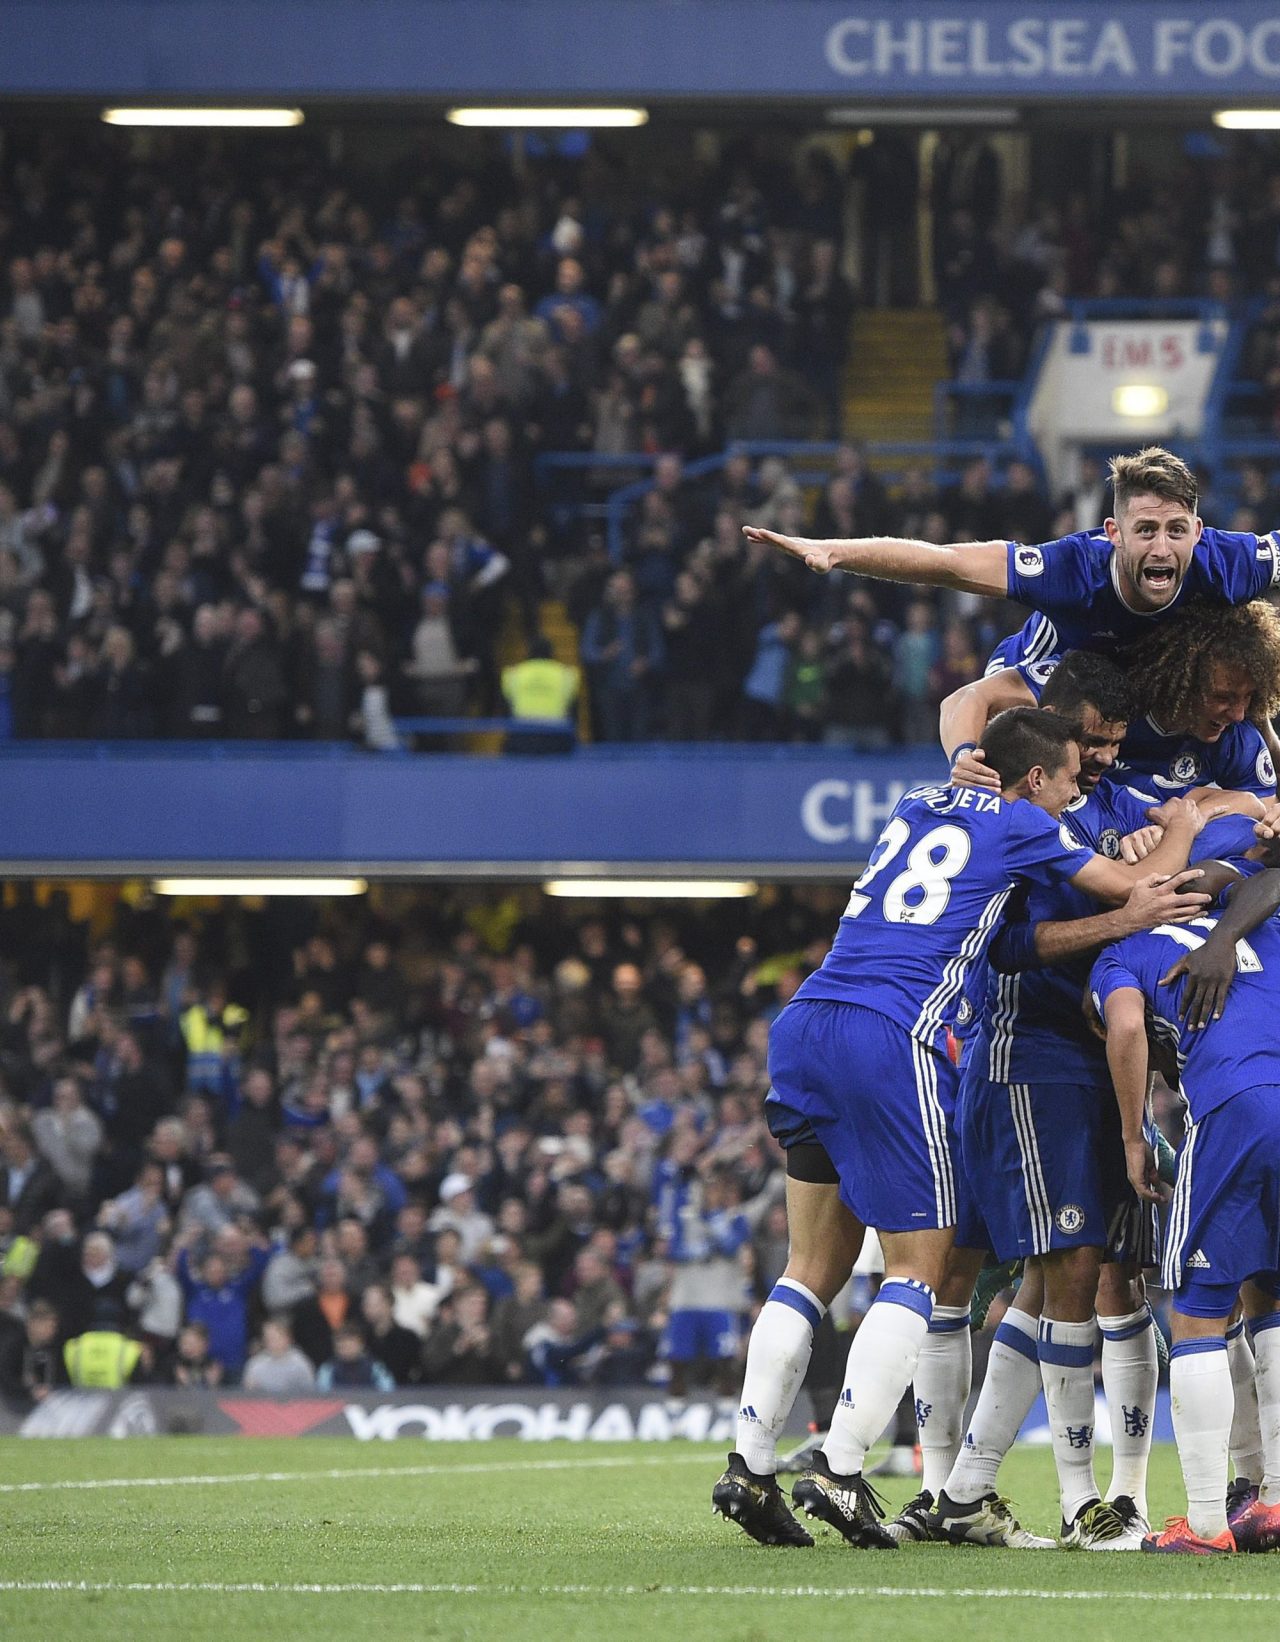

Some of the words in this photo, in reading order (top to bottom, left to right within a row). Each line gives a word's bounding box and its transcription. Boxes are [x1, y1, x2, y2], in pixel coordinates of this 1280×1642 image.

[825, 17, 1138, 78] CHELSEA
[843, 816, 972, 926] 28
[1186, 1260, 1211, 1269] adidas
